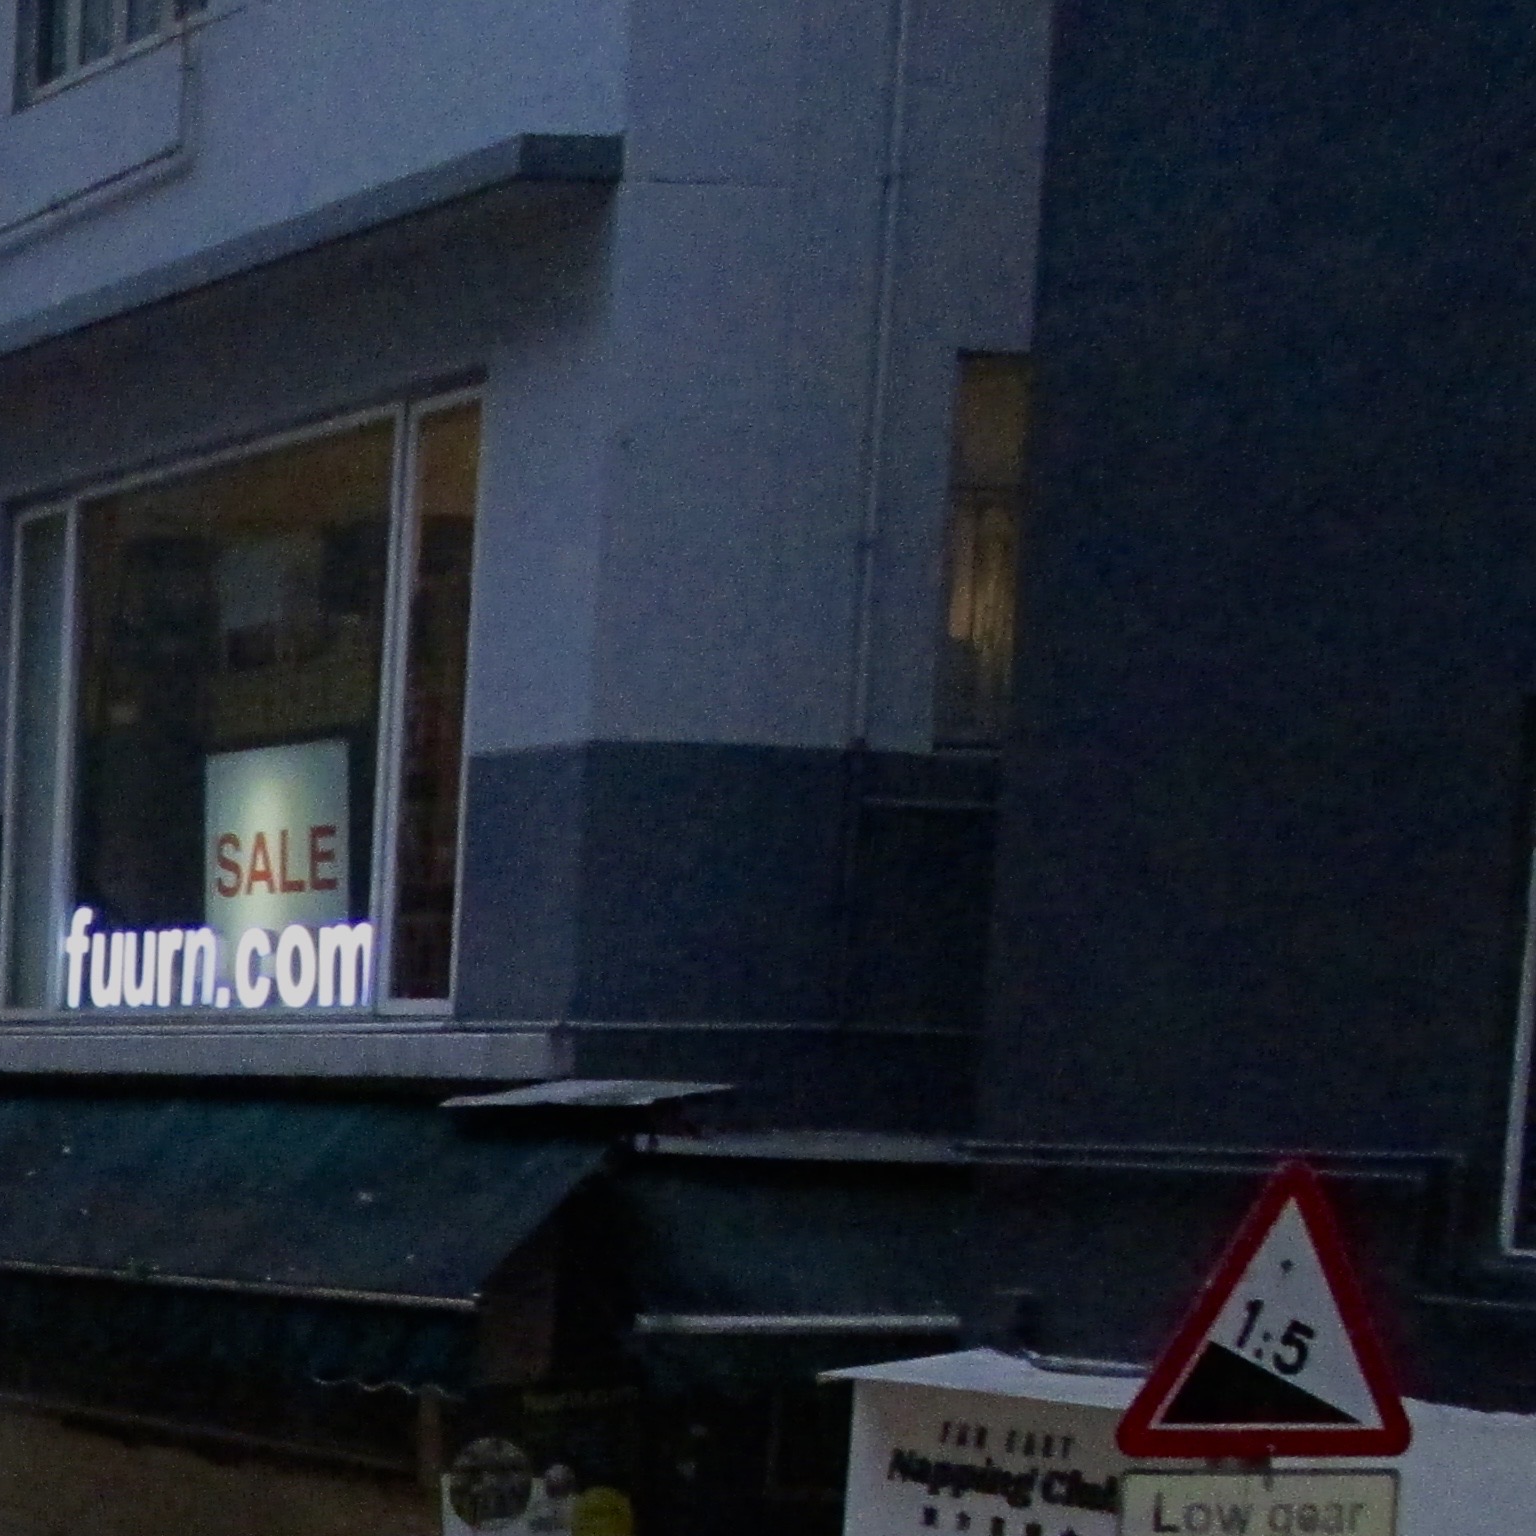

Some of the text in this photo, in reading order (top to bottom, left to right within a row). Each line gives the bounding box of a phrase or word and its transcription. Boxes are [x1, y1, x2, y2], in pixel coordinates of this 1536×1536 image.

[216, 824, 338, 898] SALE
[66, 905, 374, 1009] fuurn.com
[1237, 1299, 1315, 1376] 1:5
[1153, 1491, 1253, 1534] Low
